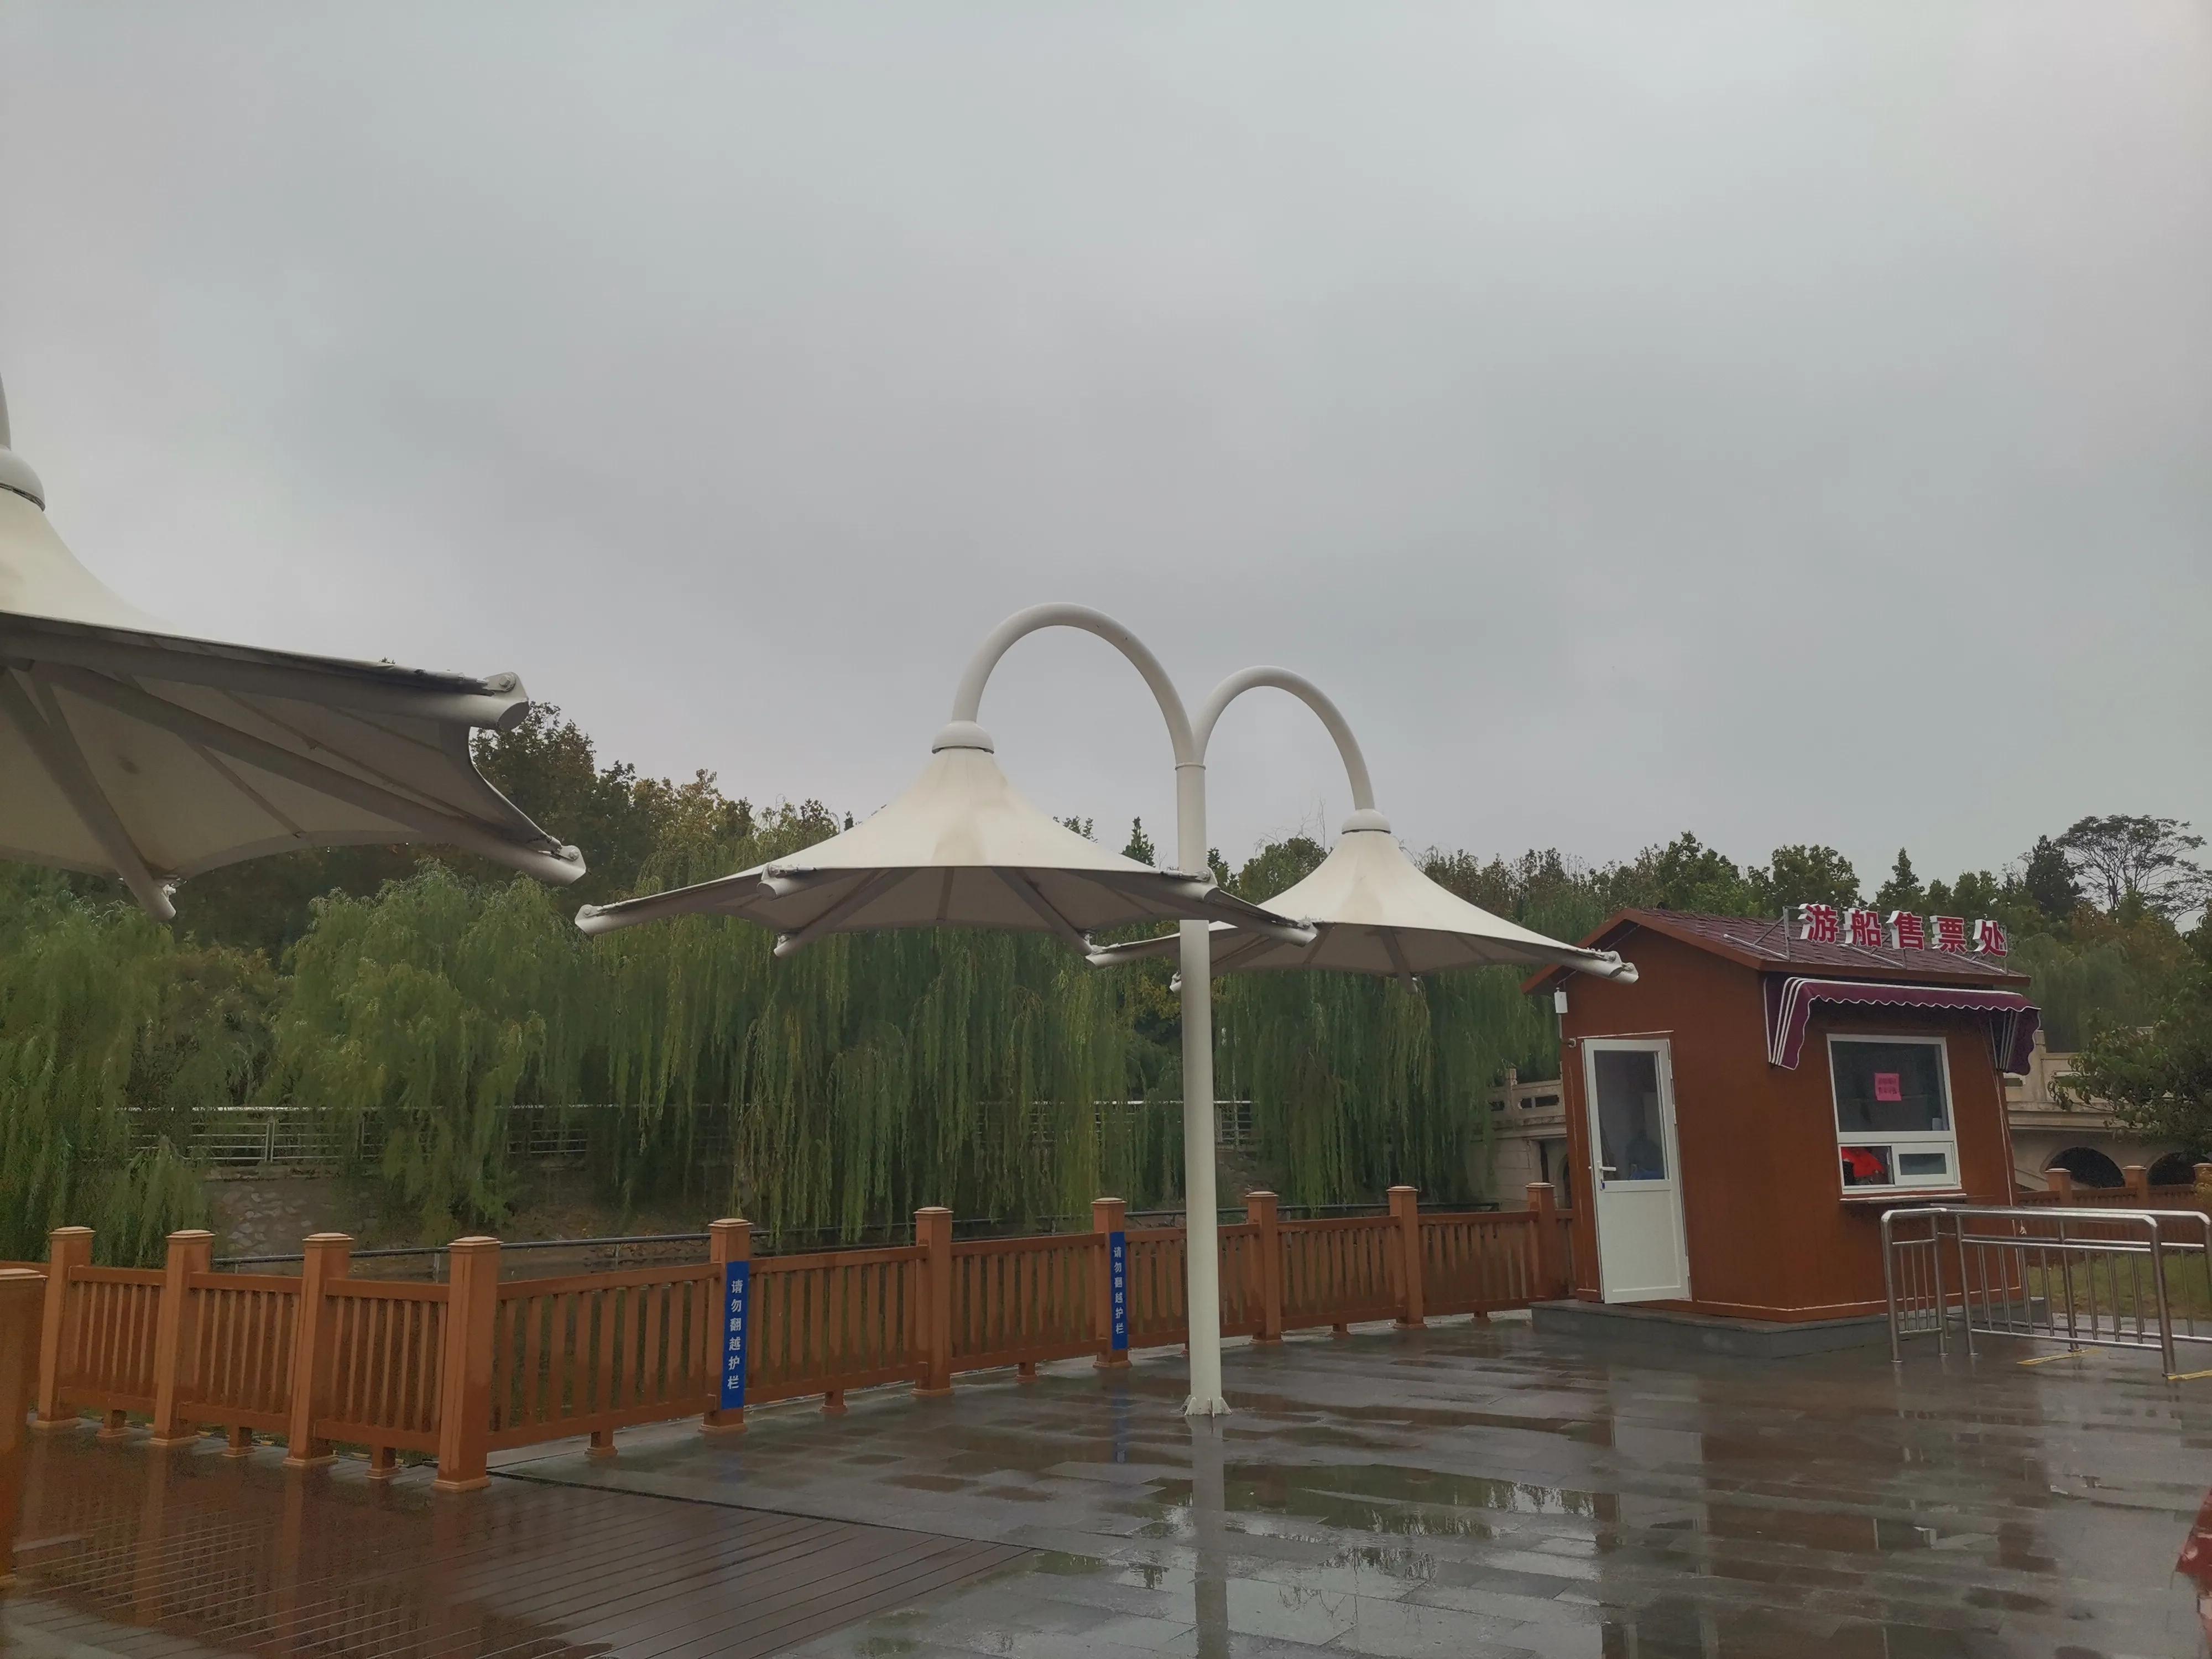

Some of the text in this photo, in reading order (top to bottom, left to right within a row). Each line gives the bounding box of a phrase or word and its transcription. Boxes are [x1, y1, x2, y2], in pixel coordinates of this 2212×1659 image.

[1798, 903, 2008, 957] 游船售票处
[727, 1279, 743, 1390] 请勿翻越护栏
